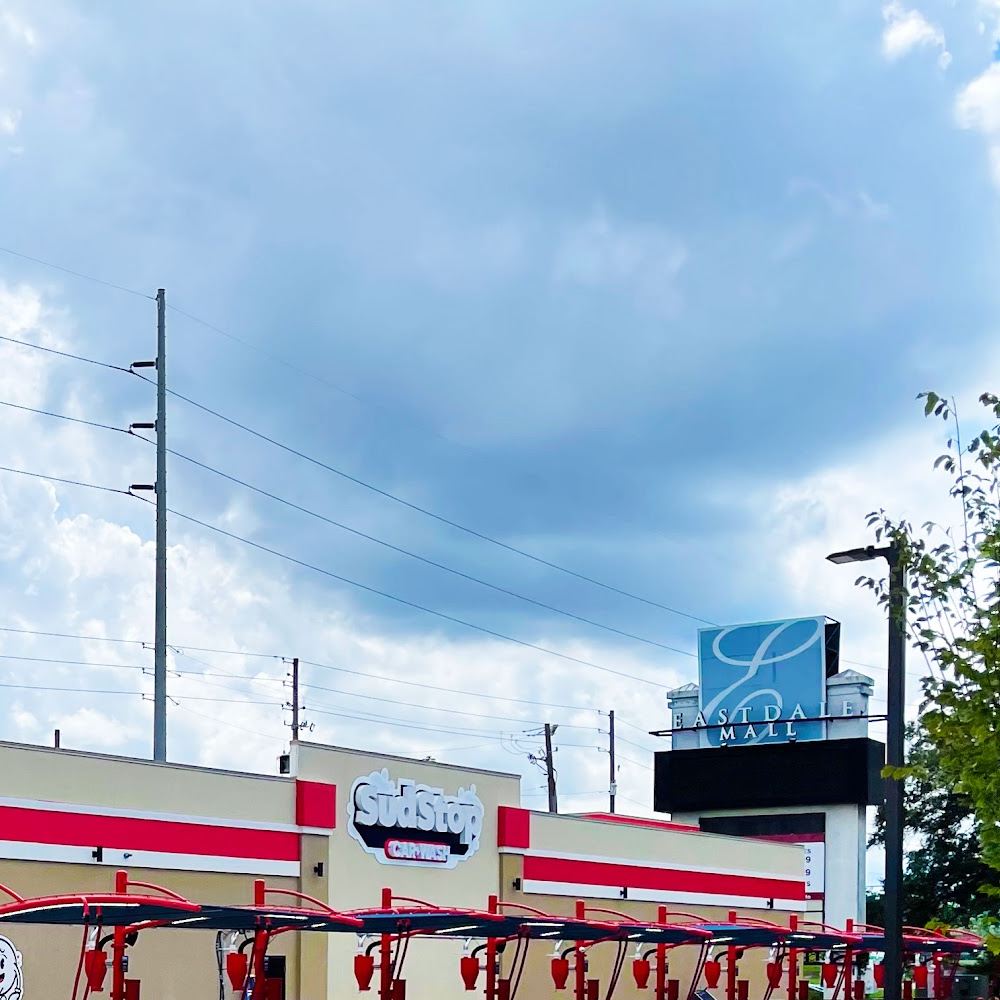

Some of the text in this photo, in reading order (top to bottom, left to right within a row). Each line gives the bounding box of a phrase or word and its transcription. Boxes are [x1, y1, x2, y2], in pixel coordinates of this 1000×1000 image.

[674, 700, 855, 729] EASTDALE
[719, 720, 798, 741] MALL
[354, 782, 482, 845] SudStop
[389, 840, 450, 861] CAR WASH
